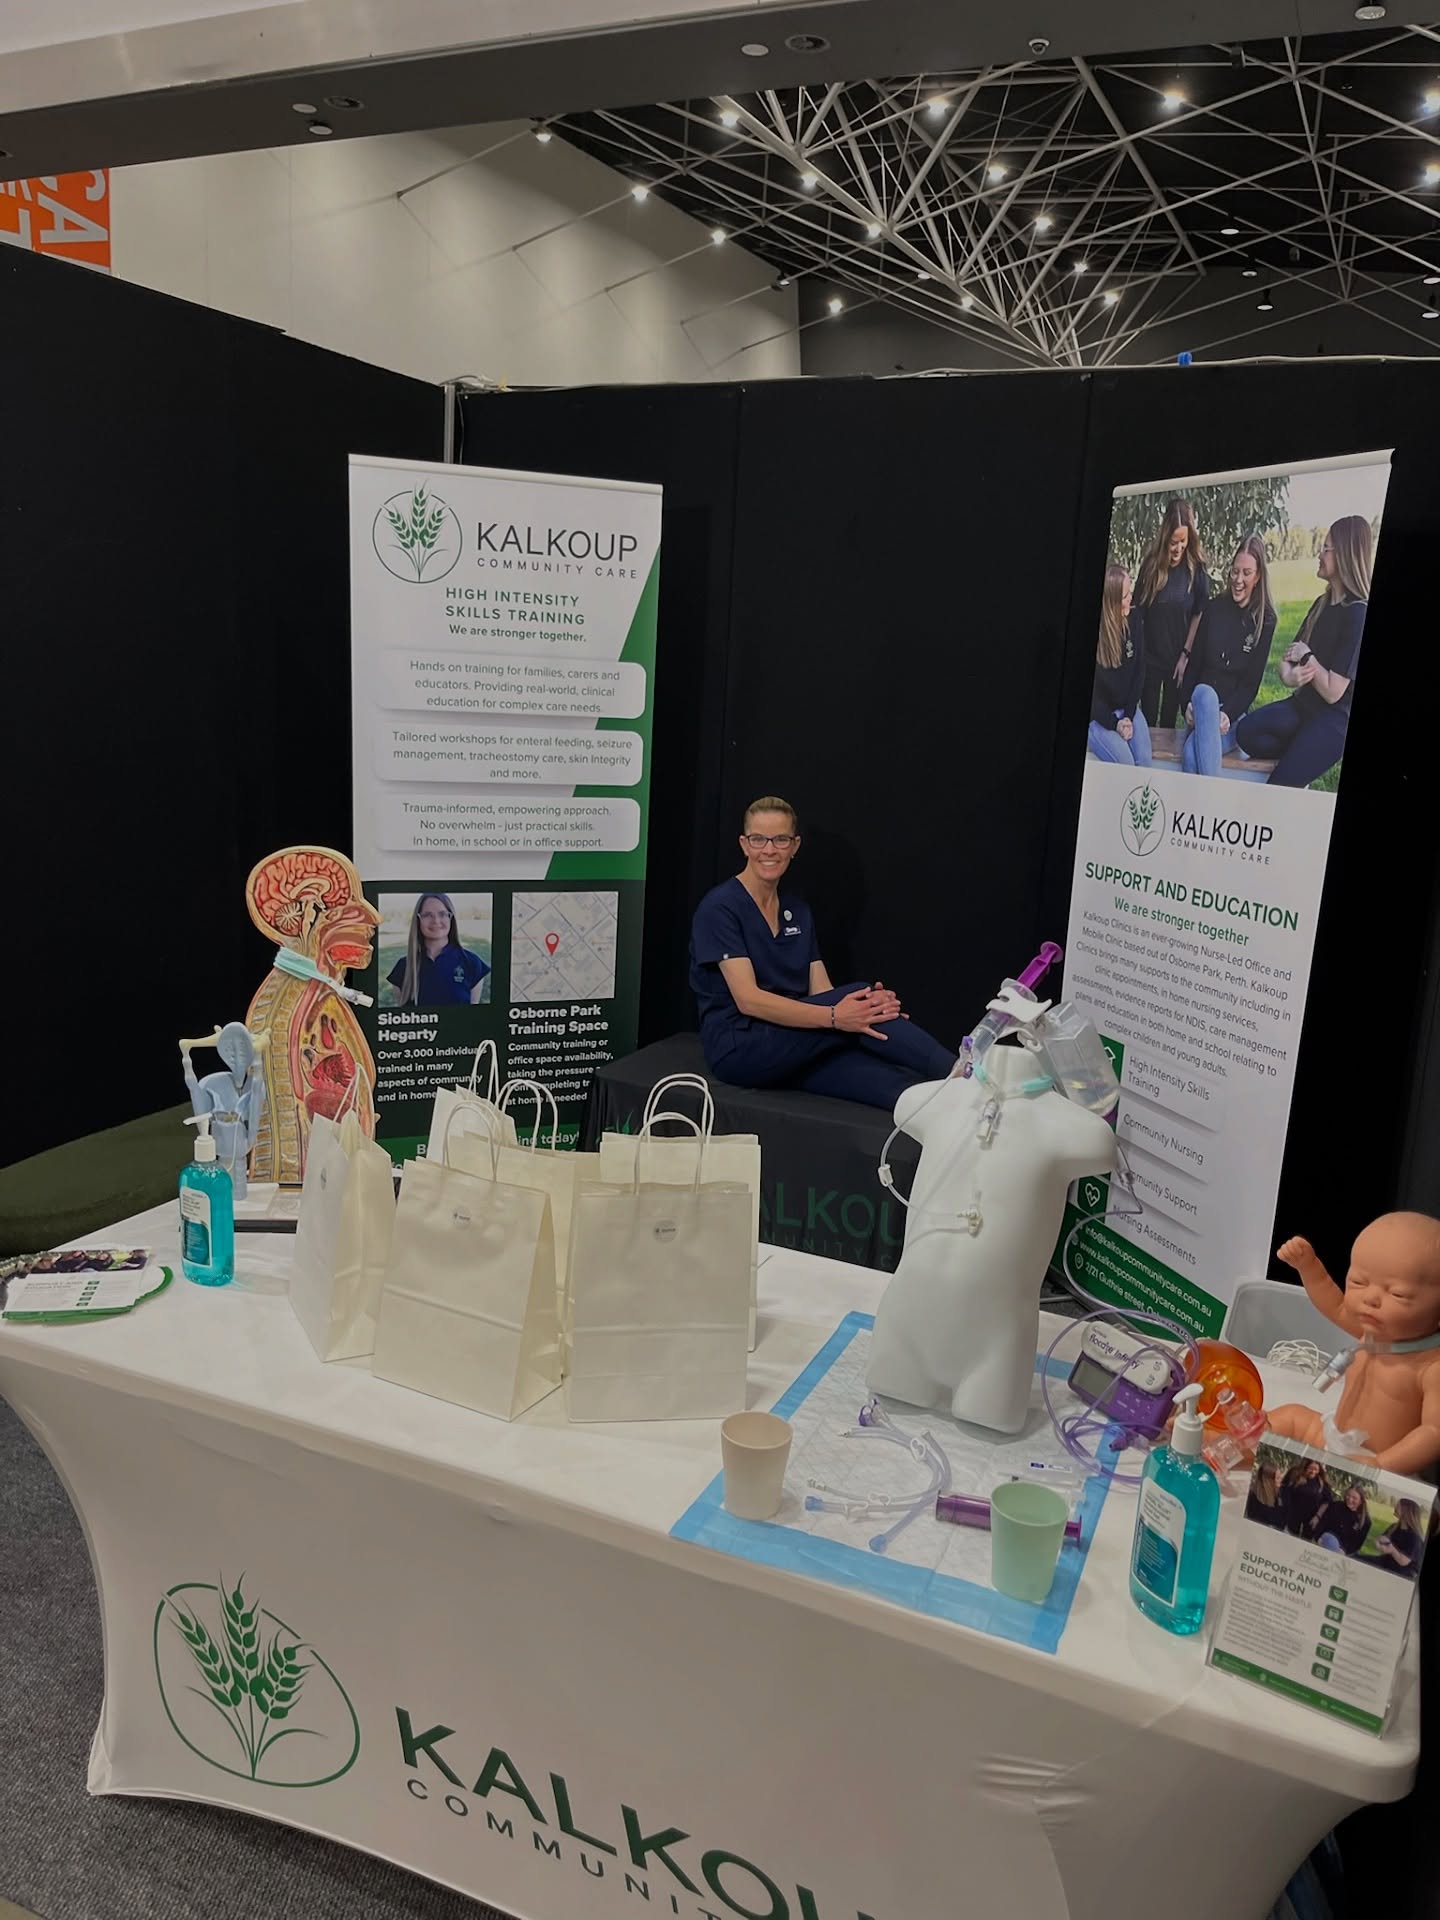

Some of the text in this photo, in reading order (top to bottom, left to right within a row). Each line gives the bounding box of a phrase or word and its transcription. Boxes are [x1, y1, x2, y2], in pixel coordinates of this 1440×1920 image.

[478, 522, 637, 562] KALKOUP
[477, 557, 636, 579] COMMUNITY CARE
[446, 587, 579, 607] HIGH INTENSITY
[446, 605, 584, 625] SKILLS TRAINING
[449, 624, 586, 642] We are stronger together.
[410, 660, 620, 680] Hands on training for families, carers and
[415, 679, 471, 690] educators.
[474, 680, 523, 695] Providing
[581, 686, 615, 696] clinical
[426, 697, 479, 708] education
[482, 698, 496, 708] for
[499, 700, 544, 713] complex
[546, 703, 568, 711] care
[392, 731, 632, 750] Tailored workshops for enteral feeding, seizure
[393, 750, 466, 761] management,
[469, 752, 540, 765] tracheostomy
[542, 755, 567, 764] care,
[569, 754, 588, 763] skin
[490, 769, 541, 779] and more.
[402, 802, 495, 815] Trauma-informed,
[498, 806, 561, 817] empowering
[420, 820, 436, 830] No
[438, 820, 496, 830] overwhelm
[504, 821, 523, 832] just
[525, 822, 567, 832] practical
[1172, 811, 1273, 850] KALKOUP
[413, 836, 603, 848] In home, in school office support.
[1170, 837, 1270, 865] COMMUNITY CARE
[1085, 862, 1299, 931] SUPPORT AND EDUCATION
[1115, 896, 1249, 946] We are stronger together
[1083, 911, 1292, 981] Kalkoup Clinics ever-growing Nurse-Led Office and
[1082, 926, 1104, 941] Mobile
[1105, 933, 1123, 948] Clinic
[1124, 940, 1146, 955] based
[1168, 954, 1201, 973] Osborne
[1250, 980, 1288, 1000] Kalkoup
[1076, 941, 1098, 956] Clinics
[1119, 957, 1138, 972] many
[1139, 964, 1170, 981] supports
[1194, 983, 1238, 1005] community
[1239, 996, 1280, 1018] including
[1282, 1010, 1291, 1021] in
[378, 1012, 438, 1025] Siobhan
[509, 1004, 601, 1019] Osborne Park
[1191, 1000, 1221, 1019] nursing
[508, 1021, 609, 1035] Training Space
[1115, 990, 1146, 1008] evidence
[1147, 1002, 1172, 1018] reports
[1209, 1025, 1227, 1039] care
[1228, 1033, 1287, 1061] management
[378, 1029, 438, 1043] Hegarty
[508, 1041, 561, 1051] Community
[563, 1039, 597, 1048] training
[1104, 1020, 1132, 1037] complex
[1132, 1031, 1161, 1048] children
[1177, 1050, 1201, 1067] young
[1107, 1003, 1265, 1073] education school relating
[377, 1051, 402, 1059] Over
[404, 1048, 434, 1059] 3,000
[508, 1056, 534, 1065] office
[535, 1056, 563, 1065] space
[377, 1063, 454, 1074] trained in many
[507, 1067, 594, 1081] taking the pressure
[1129, 1056, 1210, 1101] High Intensity Skills
[377, 1078, 415, 1089] aspects
[417, 1076, 428, 1085] of
[1128, 1071, 1160, 1098] Training
[377, 1092, 396, 1102] and
[398, 1091, 408, 1100] in
[1123, 1114, 1204, 1165] Community Nursing
[1164, 1187, 1197, 1216] Support
[1143, 1224, 1196, 1265] Assessments
[1240, 1563, 1306, 1595] EDUCATION
[1243, 1551, 1295, 1578] SUPPORT
[1297, 1573, 1322, 1589] AND
[395, 1706, 875, 1920] KALKO
